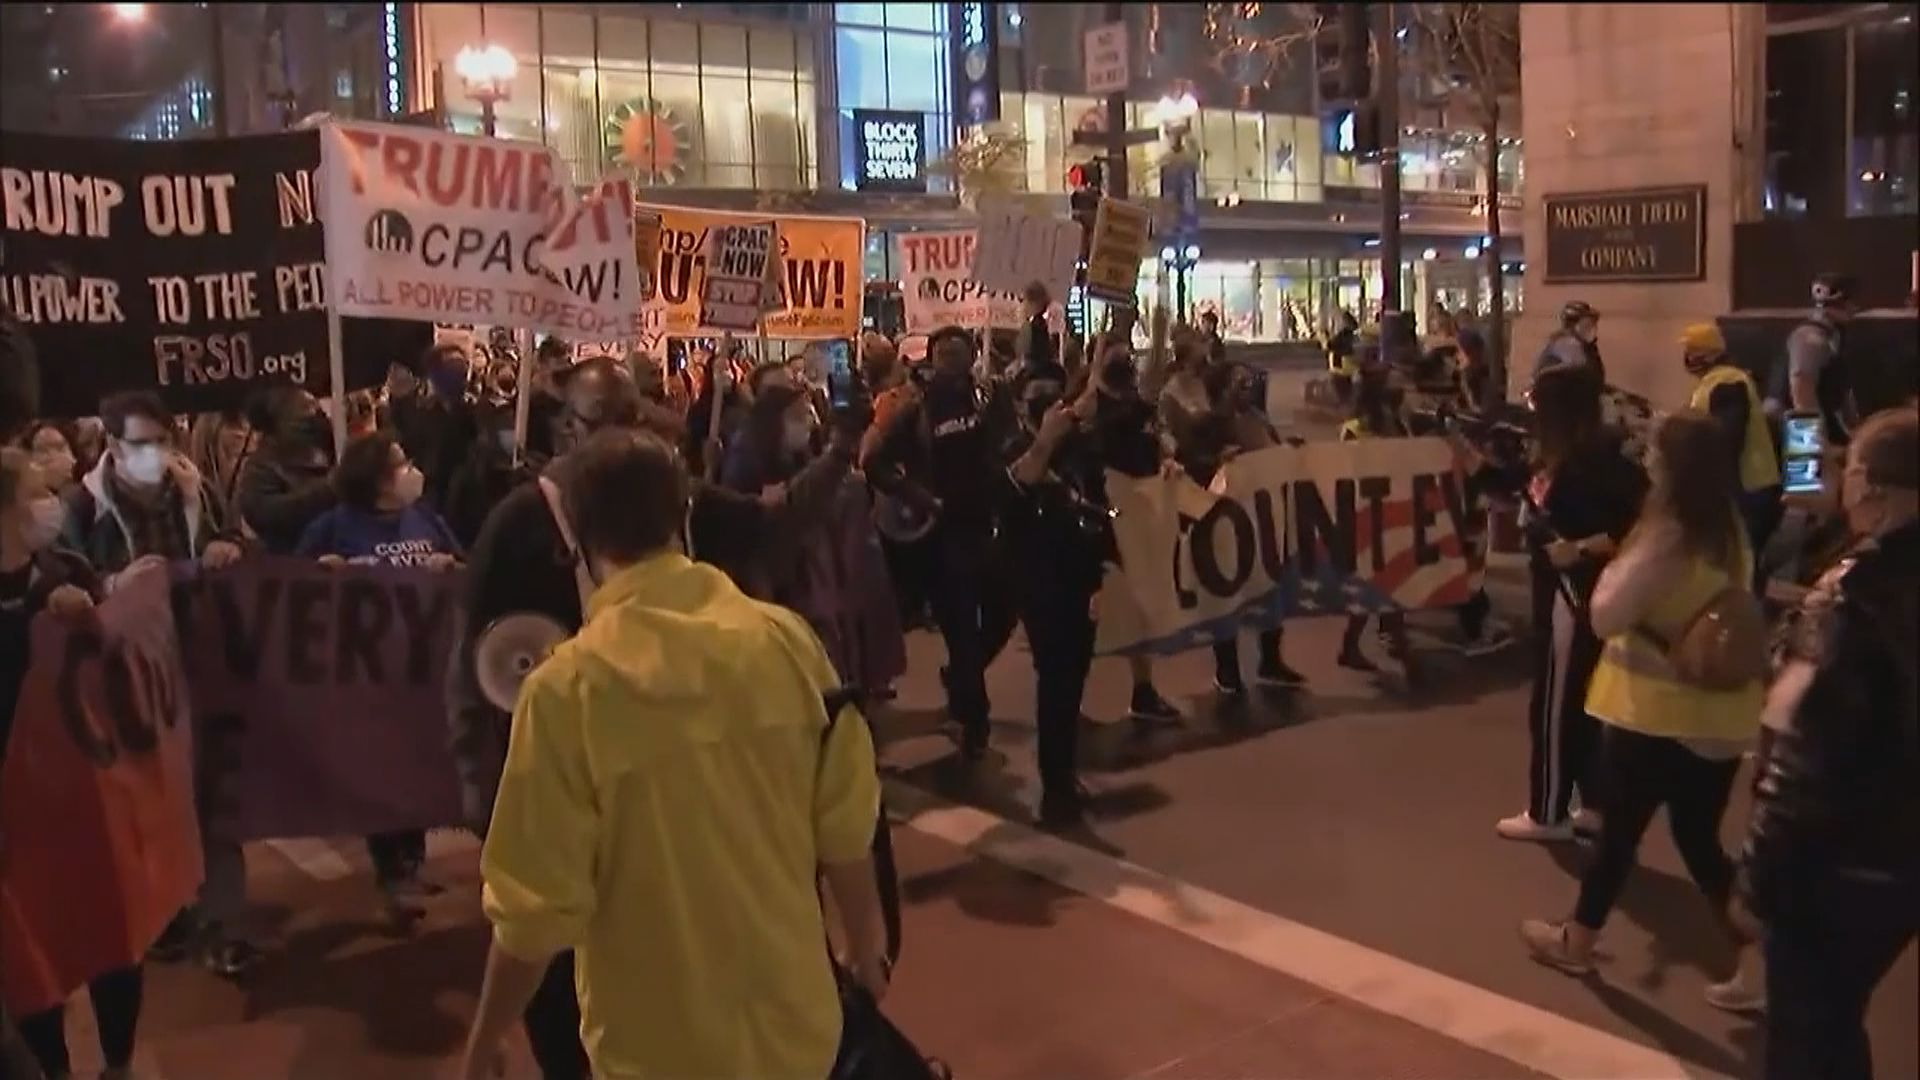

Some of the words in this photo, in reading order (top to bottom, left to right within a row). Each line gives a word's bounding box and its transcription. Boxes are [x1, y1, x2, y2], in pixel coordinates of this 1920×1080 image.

[864, 121, 917, 141] BLOCK
[865, 141, 918, 160] THIRTY
[343, 130, 555, 214] TRUMP
[866, 160, 917, 179] SEVEN
[1, 168, 124, 238] RUMP
[141, 174, 235, 236] OUT
[1556, 204, 1631, 228] MARSHALL
[1641, 202, 1688, 225] FIELD
[421, 222, 541, 276] CPAC
[1581, 246, 1658, 269] COMPANY
[721, 249, 767, 278] NOW
[148, 277, 190, 324] TO
[195, 272, 261, 320] THE
[344, 277, 392, 305] ALL
[398, 281, 493, 313] POWER
[504, 289, 537, 317] TO
[375, 540, 432, 557] COUNT
